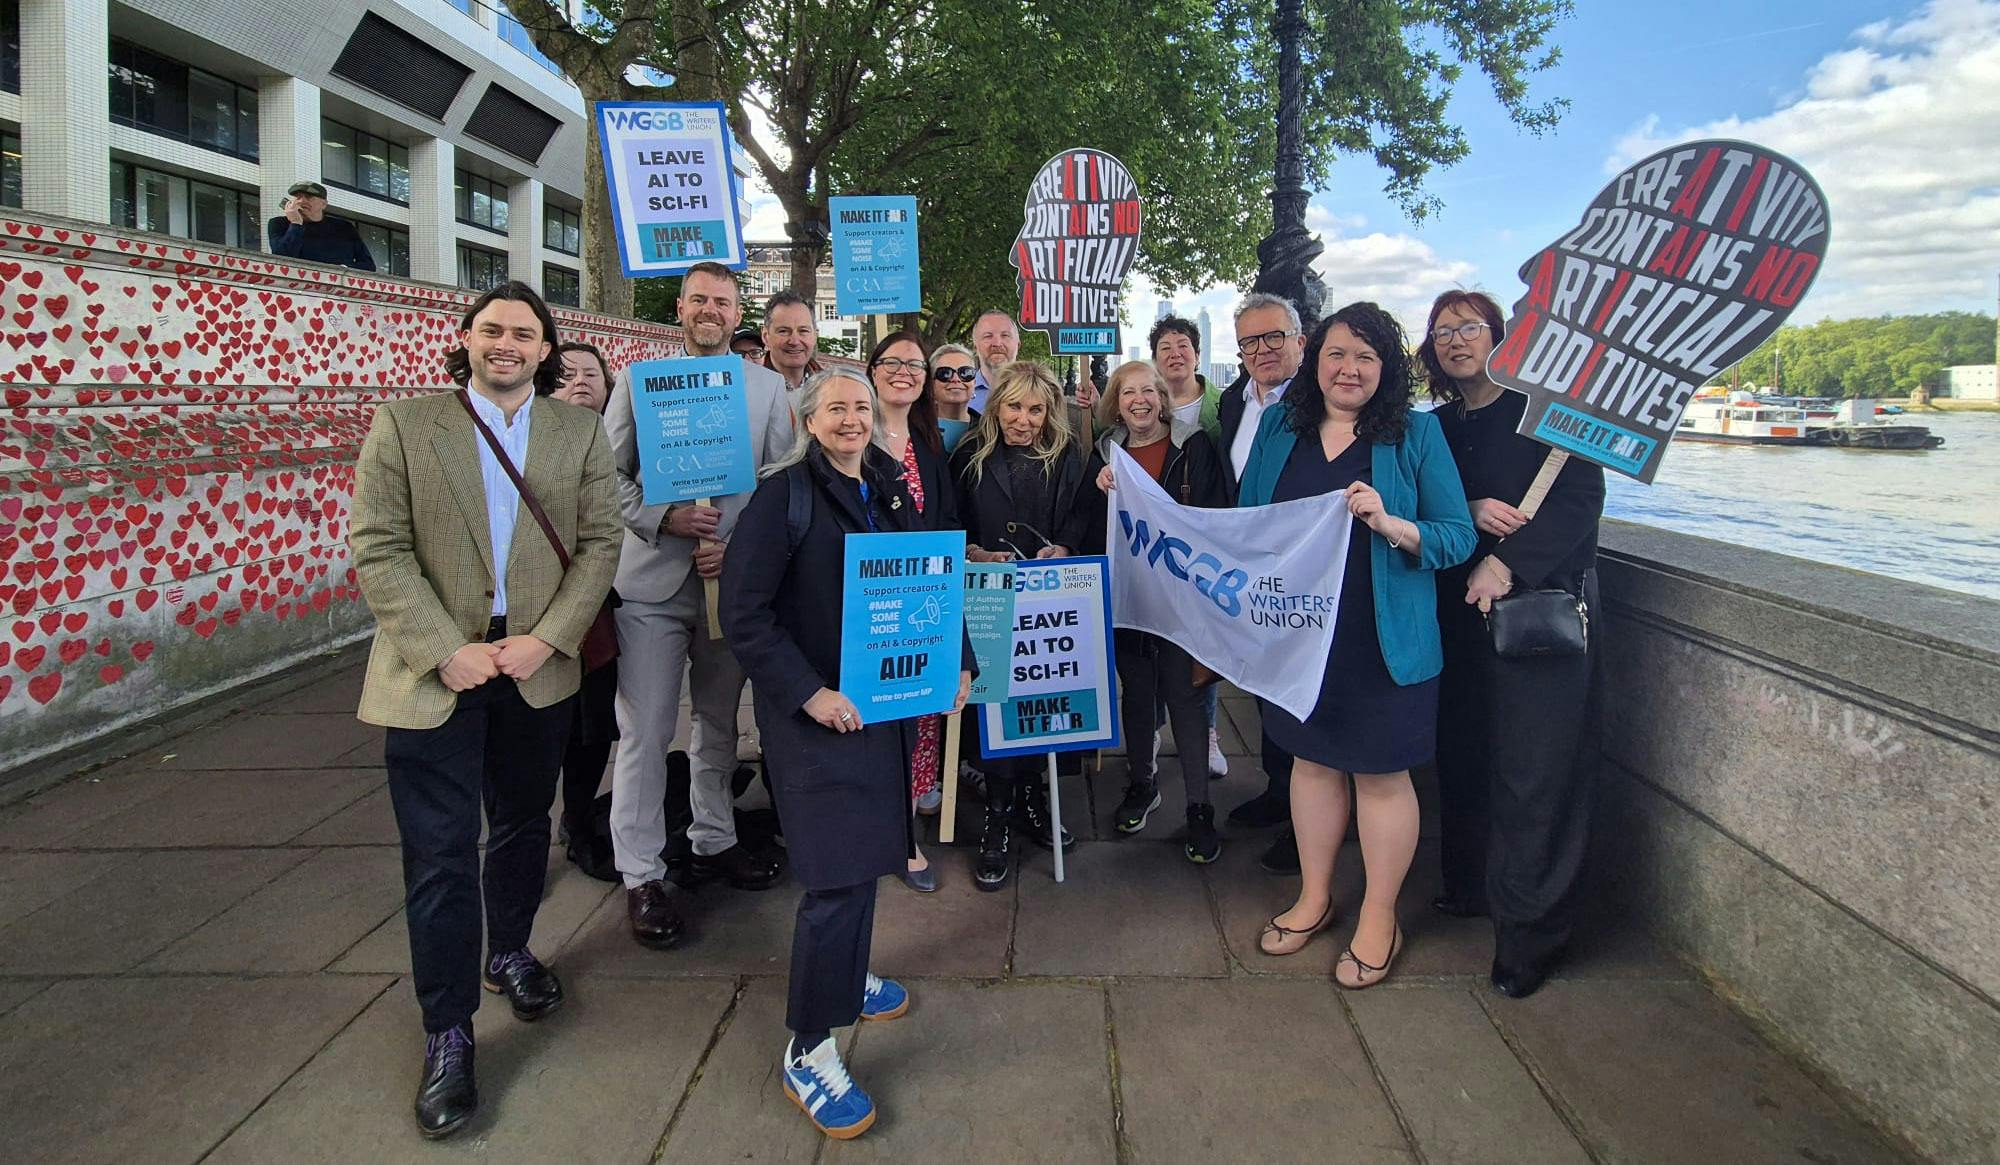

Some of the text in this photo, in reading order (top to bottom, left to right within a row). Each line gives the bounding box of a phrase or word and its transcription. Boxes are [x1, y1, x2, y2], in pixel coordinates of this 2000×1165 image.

[607, 111, 684, 131] WGGB
[637, 150, 705, 166] LEAVE
[648, 172, 703, 188] AI TO
[1033, 154, 1134, 203] CREATIVITY
[648, 195, 708, 211] SCI-FI
[1616, 148, 1825, 248] CREATIVITY
[840, 209, 908, 224] MAKE IT FAIR
[1022, 201, 1139, 239] CONTAINS NO
[653, 226, 703, 243] MAKE
[844, 230, 871, 238] Support
[656, 241, 714, 258] IT FAIR
[1559, 208, 1819, 308] CONTAINS NO
[1017, 237, 1132, 285] ARTIFICIAL
[846, 277, 881, 293] CRA
[1020, 280, 1118, 324] ADDITIVES
[1527, 251, 1774, 377] ARTIFICIAL
[1061, 332, 1112, 345] MAKE IT FAIR
[1491, 311, 1694, 432] ADDITIVES
[645, 371, 733, 393] MAKE IT FAIR
[651, 397, 685, 409] Support
[687, 395, 722, 404] creators
[661, 418, 689, 428] SOME
[662, 428, 689, 438] NOISE
[673, 440, 682, 448] AI
[692, 435, 732, 446] Copyright
[1544, 408, 1592, 439] MAKE
[1588, 425, 1611, 446] IT
[1607, 432, 1649, 461] FAIR
[656, 453, 703, 474] CRA
[700, 476, 716, 484] your
[859, 555, 953, 579] MAKE IT FAIR
[1063, 567, 1078, 575] THE
[1118, 510, 1249, 618] WGGB
[980, 572, 1013, 589] FAIR
[1015, 569, 1060, 592] GGB
[1063, 574, 1097, 582] WRITERS
[1064, 581, 1092, 589] UNION
[1252, 576, 1285, 593] THE
[863, 582, 948, 597] Support creators &
[868, 600, 903, 611] #MAKE
[1248, 591, 1336, 613] WRITERS
[871, 612, 900, 623] SOME
[1249, 610, 1324, 630] UNION
[870, 623, 901, 635] NOISE
[866, 642, 879, 650] on
[880, 640, 890, 648] AI
[901, 635, 944, 647] Copyright
[1014, 636, 1074, 656] AI TO
[879, 652, 929, 681] AOP
[1013, 661, 1079, 682] SCI-FI
[871, 687, 933, 703] Write to your MP
[1017, 696, 1071, 717] MAKE
[1019, 713, 1083, 735] IT FAIR
